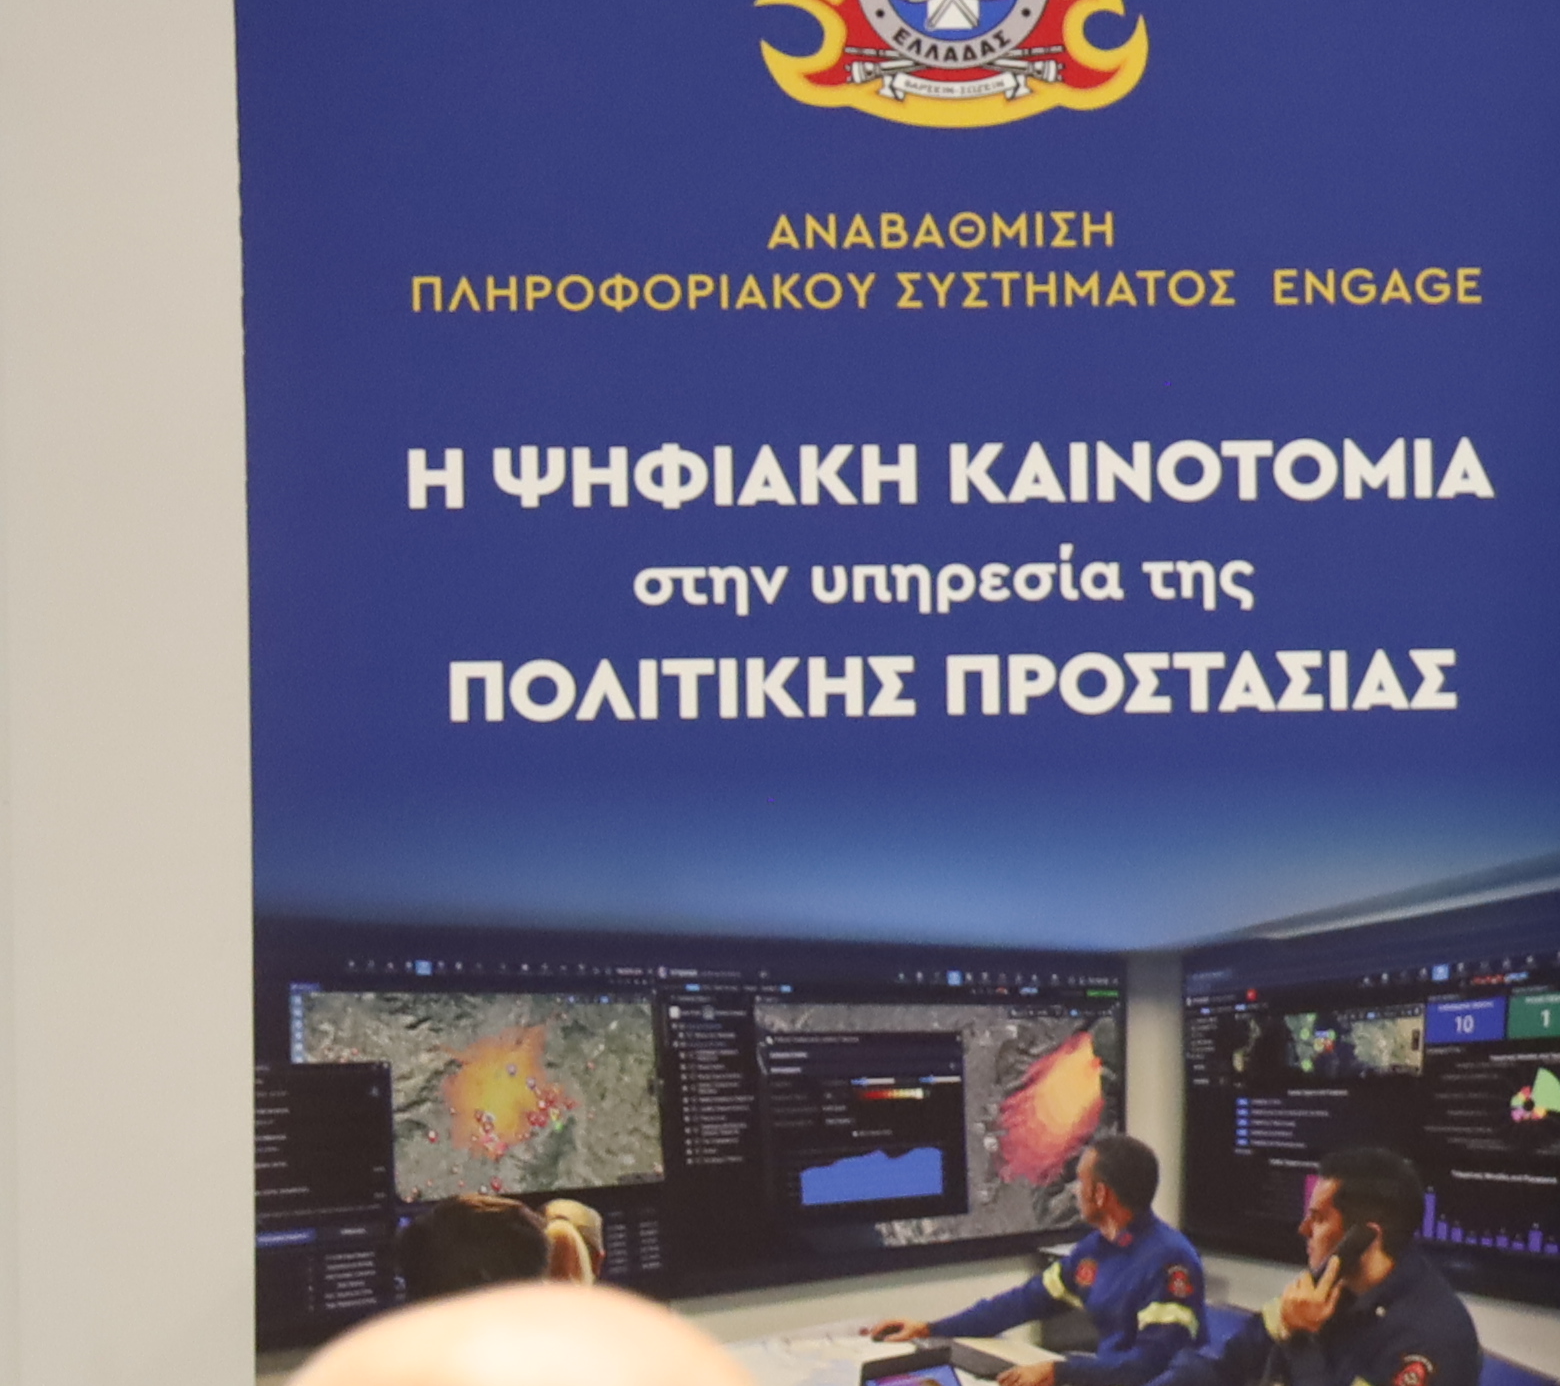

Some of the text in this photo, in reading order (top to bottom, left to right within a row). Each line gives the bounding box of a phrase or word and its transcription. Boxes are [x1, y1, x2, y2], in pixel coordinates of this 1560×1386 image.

[892, 27, 1012, 63] ΕΛΛΑΔΑΣ
[767, 211, 1114, 250] ΑΝΑΒΑΘΜΙΣΗ
[412, 267, 1482, 313] ΠΛΗΡΟΦΟΡΙΑΚΟΥ ΣΥΣΤΗΜΑΤΟΣ ENGAGE
[407, 436, 1495, 510] Η ΨΗΦΙΑΚΗ ΚΑΙΝΟΤΟΜΙΑ
[633, 543, 1255, 617] στην υπηρεσία της
[449, 648, 1458, 723] ΠΟΛΙΤΙΚΗΣ ΠΡΟΣΤΑΣΙΑΣ
[1455, 1014, 1475, 1034] 10
[1541, 1009, 1551, 1028] 1
